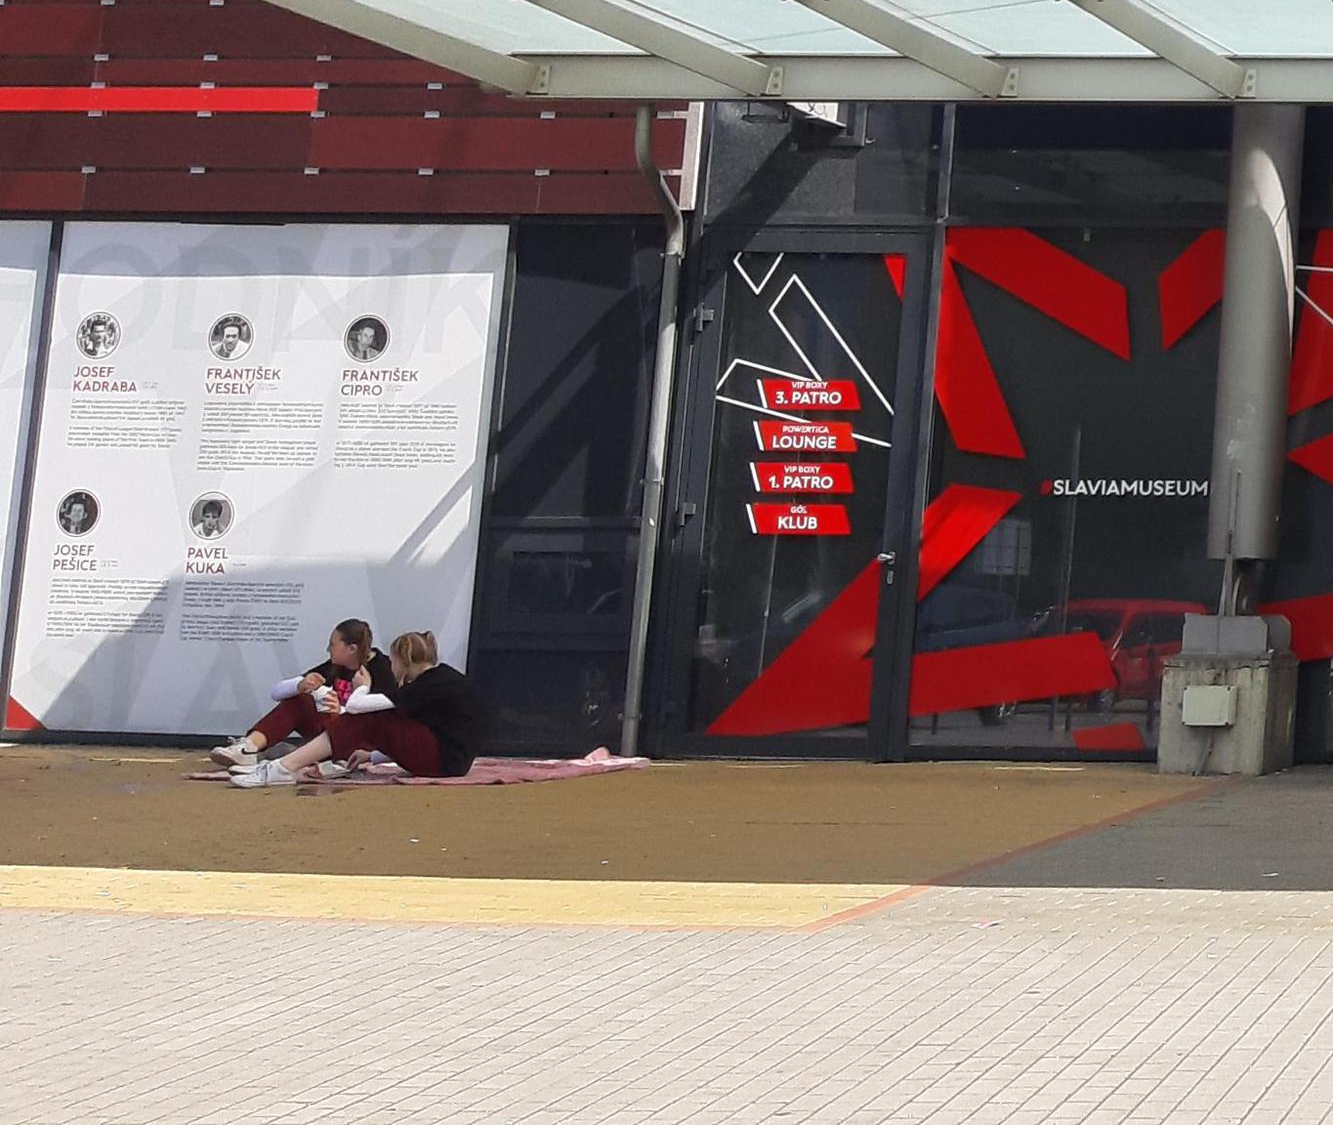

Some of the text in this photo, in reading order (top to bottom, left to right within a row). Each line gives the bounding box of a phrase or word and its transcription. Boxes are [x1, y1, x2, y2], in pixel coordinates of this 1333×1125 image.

[74, 366, 114, 378] JOSEF
[207, 366, 281, 381] FRANTIŠEK
[342, 367, 419, 382] FRANTIŠEK
[73, 381, 137, 392] KADRABA
[205, 381, 255, 394] VESELÝ
[341, 384, 383, 396] CIPRO
[792, 381, 805, 389] VIP
[775, 391, 842, 404] 3. PATRO
[772, 436, 837, 449] LOUNGE
[784, 466, 797, 474] VIP
[769, 476, 833, 489] 1. PATRO
[777, 516, 818, 529] KLUB
[53, 544, 95, 556] JOSEF
[187, 547, 229, 559] PAVEL
[53, 557, 97, 571] PEŠICE
[186, 561, 225, 574] KUKA
